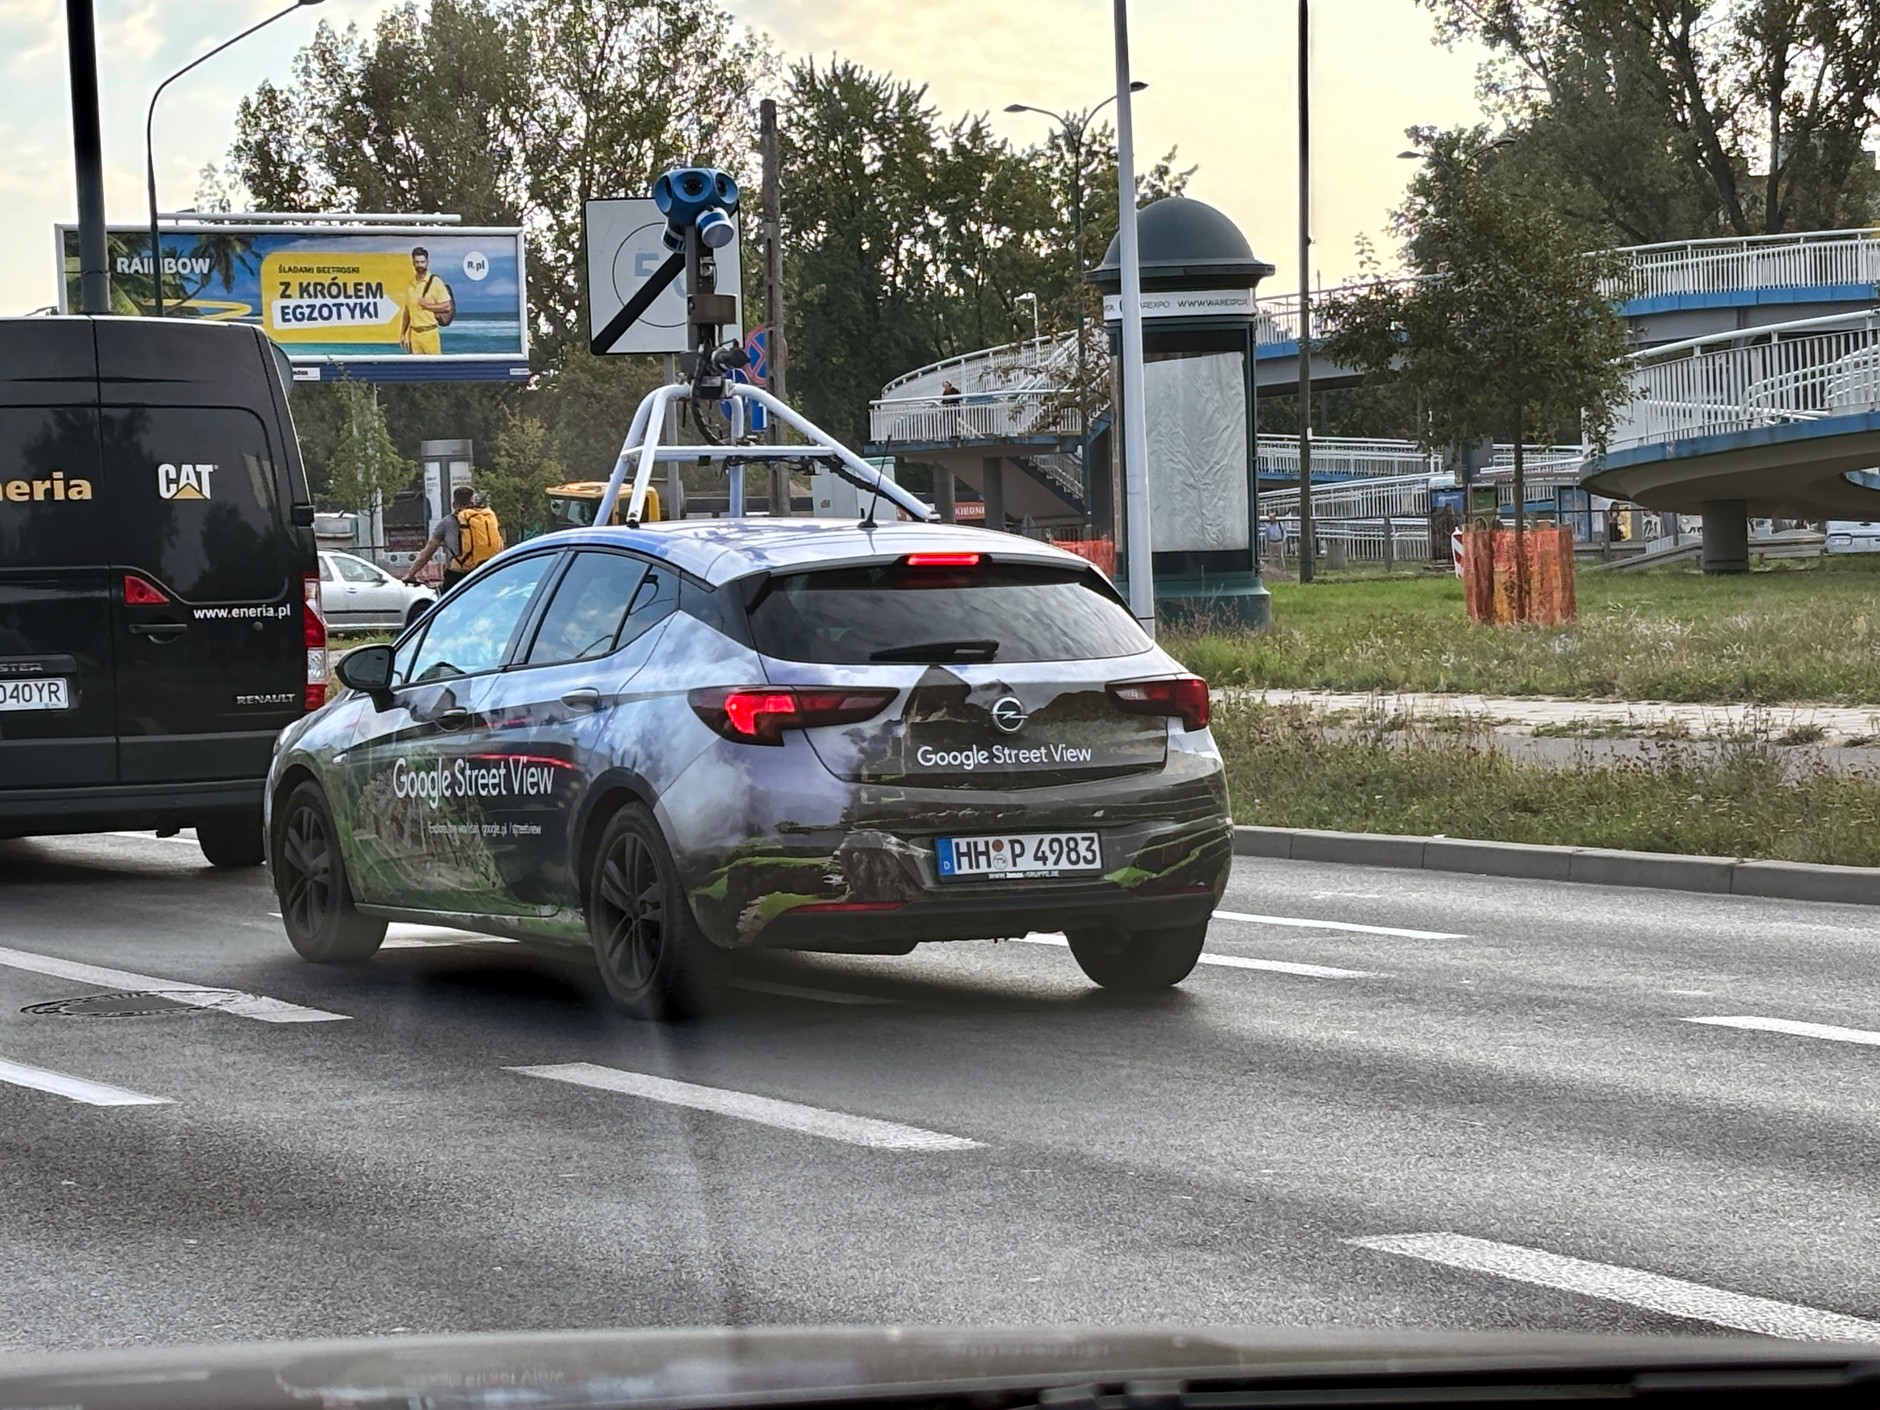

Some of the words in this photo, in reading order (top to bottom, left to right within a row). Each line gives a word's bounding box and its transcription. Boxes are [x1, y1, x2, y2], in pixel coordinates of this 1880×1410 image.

[279, 281, 293, 299] Z
[298, 276, 384, 300] KRÓLEM
[280, 301, 380, 324] EGZOTYKI
[157, 463, 214, 500] CAT
[193, 603, 291, 620] www.eneria.pl
[236, 693, 296, 705] RENAULT
[916, 744, 990, 771] Google
[992, 745, 1048, 764] Street
[1049, 744, 1092, 762] View
[393, 757, 452, 810] Google
[454, 758, 508, 798] Street
[508, 755, 555, 796] View
[954, 840, 992, 871] HH
[1008, 839, 1026, 868] P
[1033, 836, 1098, 867] 4983
